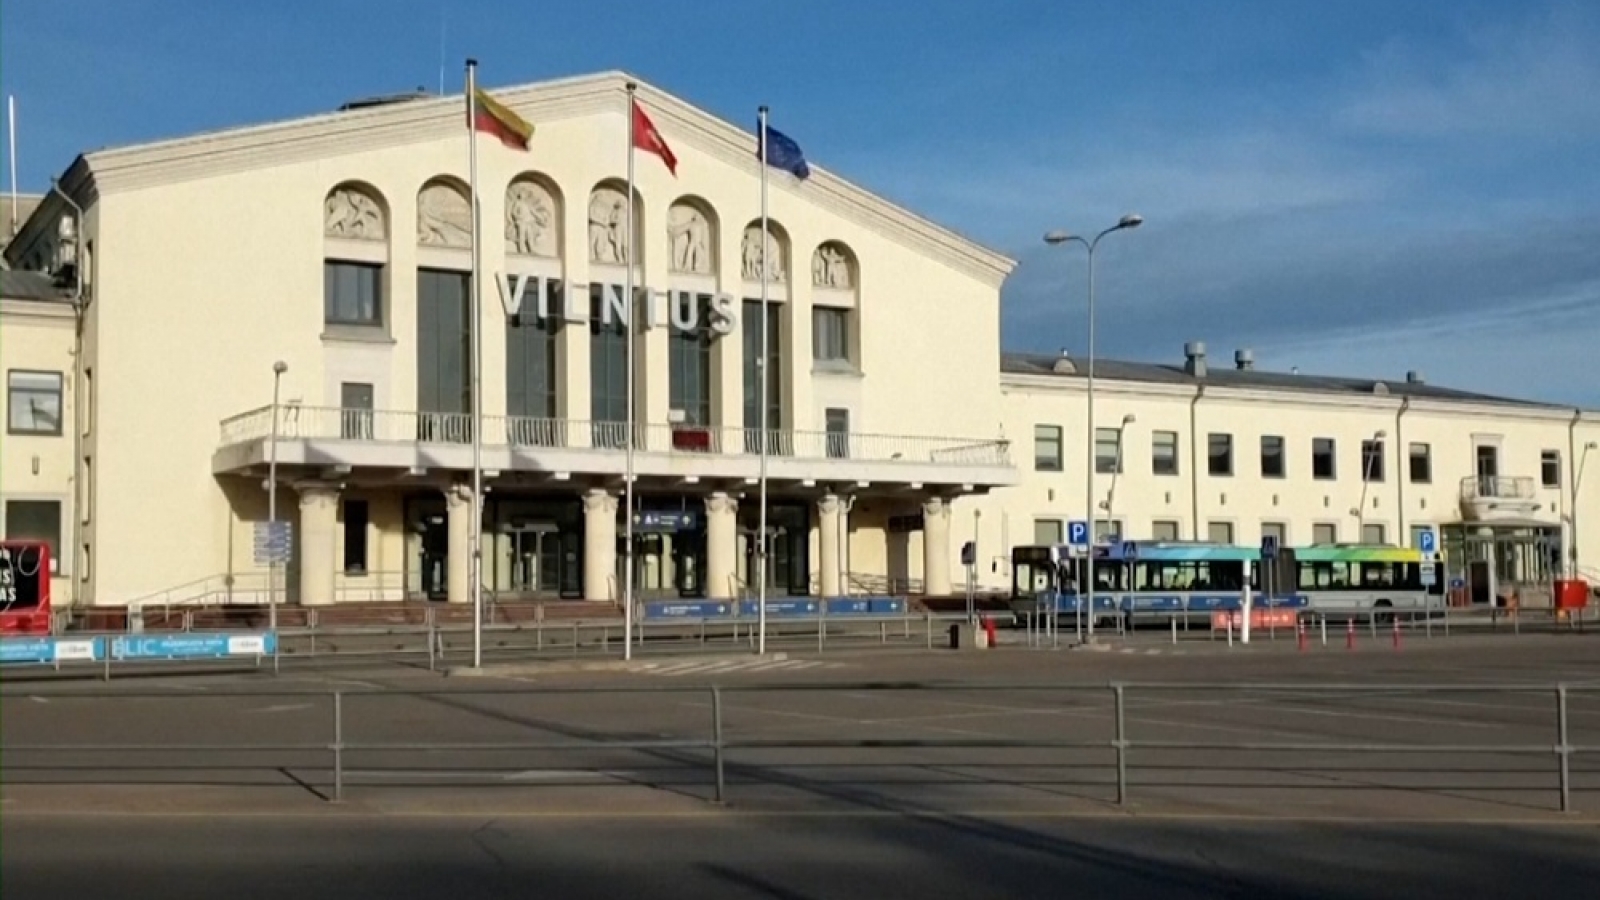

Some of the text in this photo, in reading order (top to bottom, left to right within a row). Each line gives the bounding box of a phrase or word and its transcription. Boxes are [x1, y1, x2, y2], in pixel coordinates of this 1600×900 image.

[495, 272, 737, 333] VILNIUS
[1073, 523, 1084, 543] P
[1423, 533, 1432, 549] P
